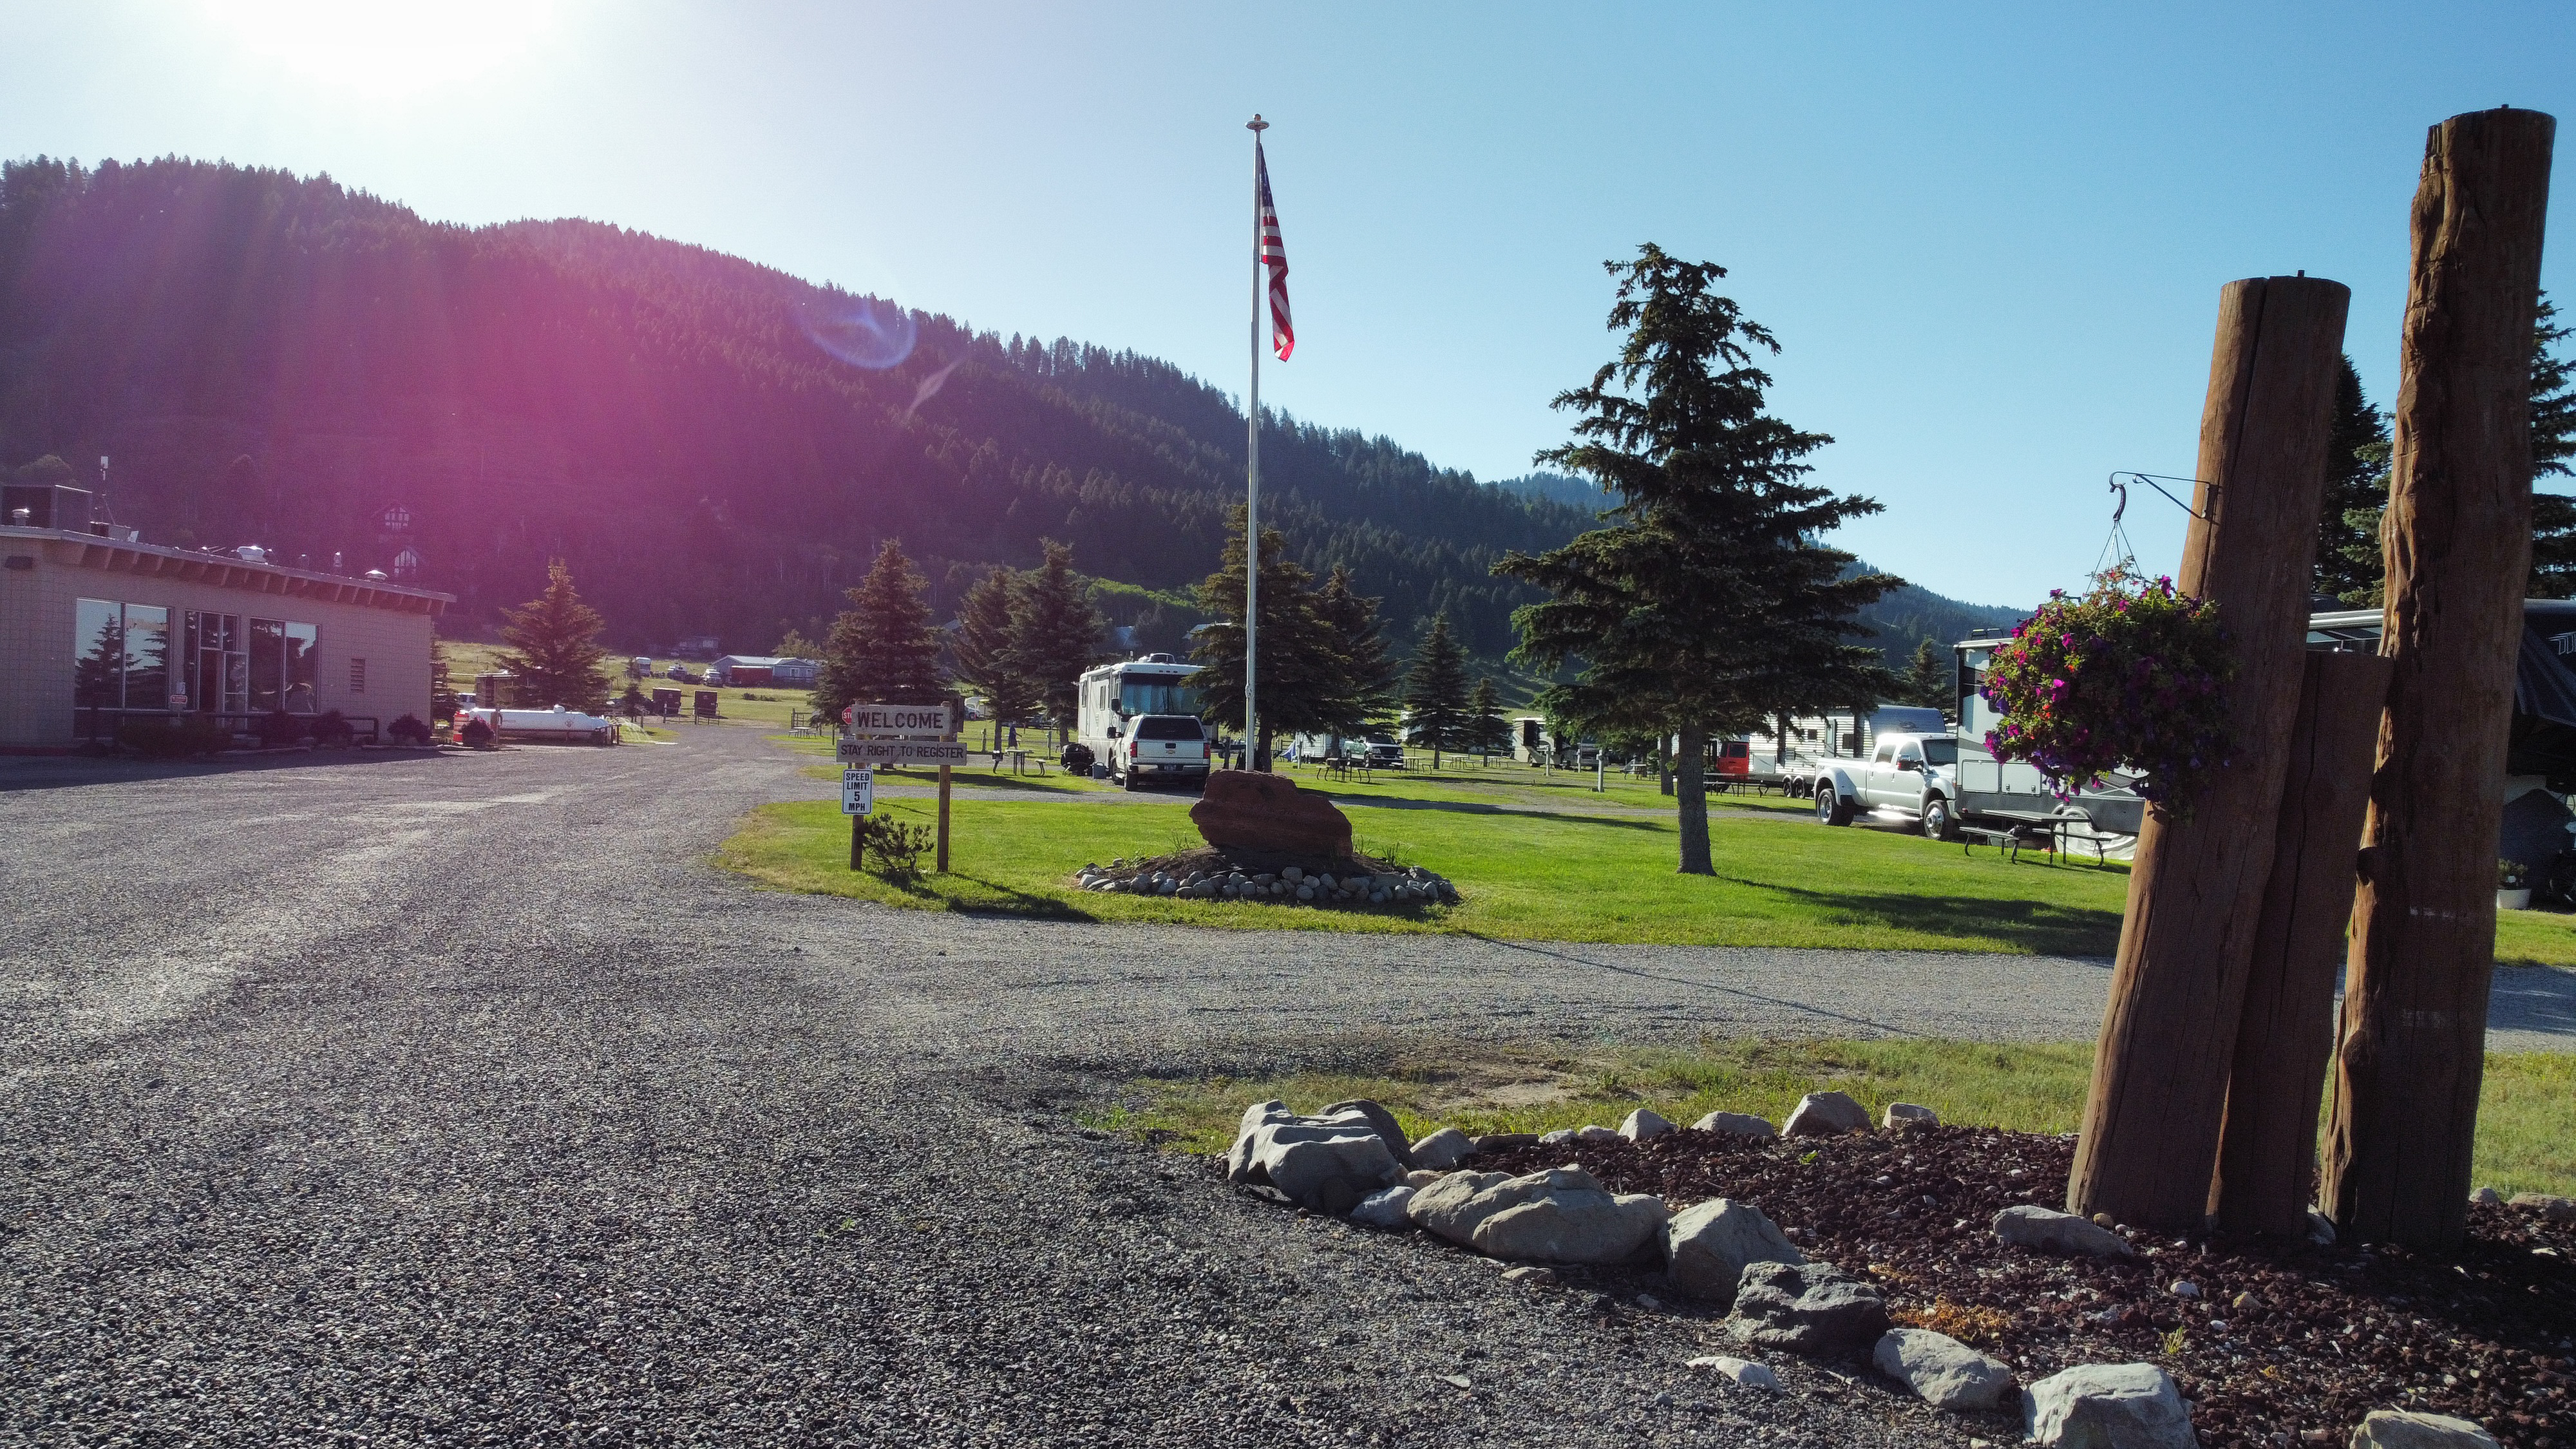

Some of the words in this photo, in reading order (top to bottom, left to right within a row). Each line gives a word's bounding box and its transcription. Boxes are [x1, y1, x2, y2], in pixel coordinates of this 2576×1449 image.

[857, 712, 944, 729] WELCOME
[840, 744, 862, 755] STAY
[867, 745, 895, 756] RIGHT
[900, 746, 913, 757] TO
[916, 746, 963, 759] REGISTER
[846, 773, 869, 781] SPEED
[847, 782, 868, 790] LIMIT
[854, 791, 860, 801] 5
